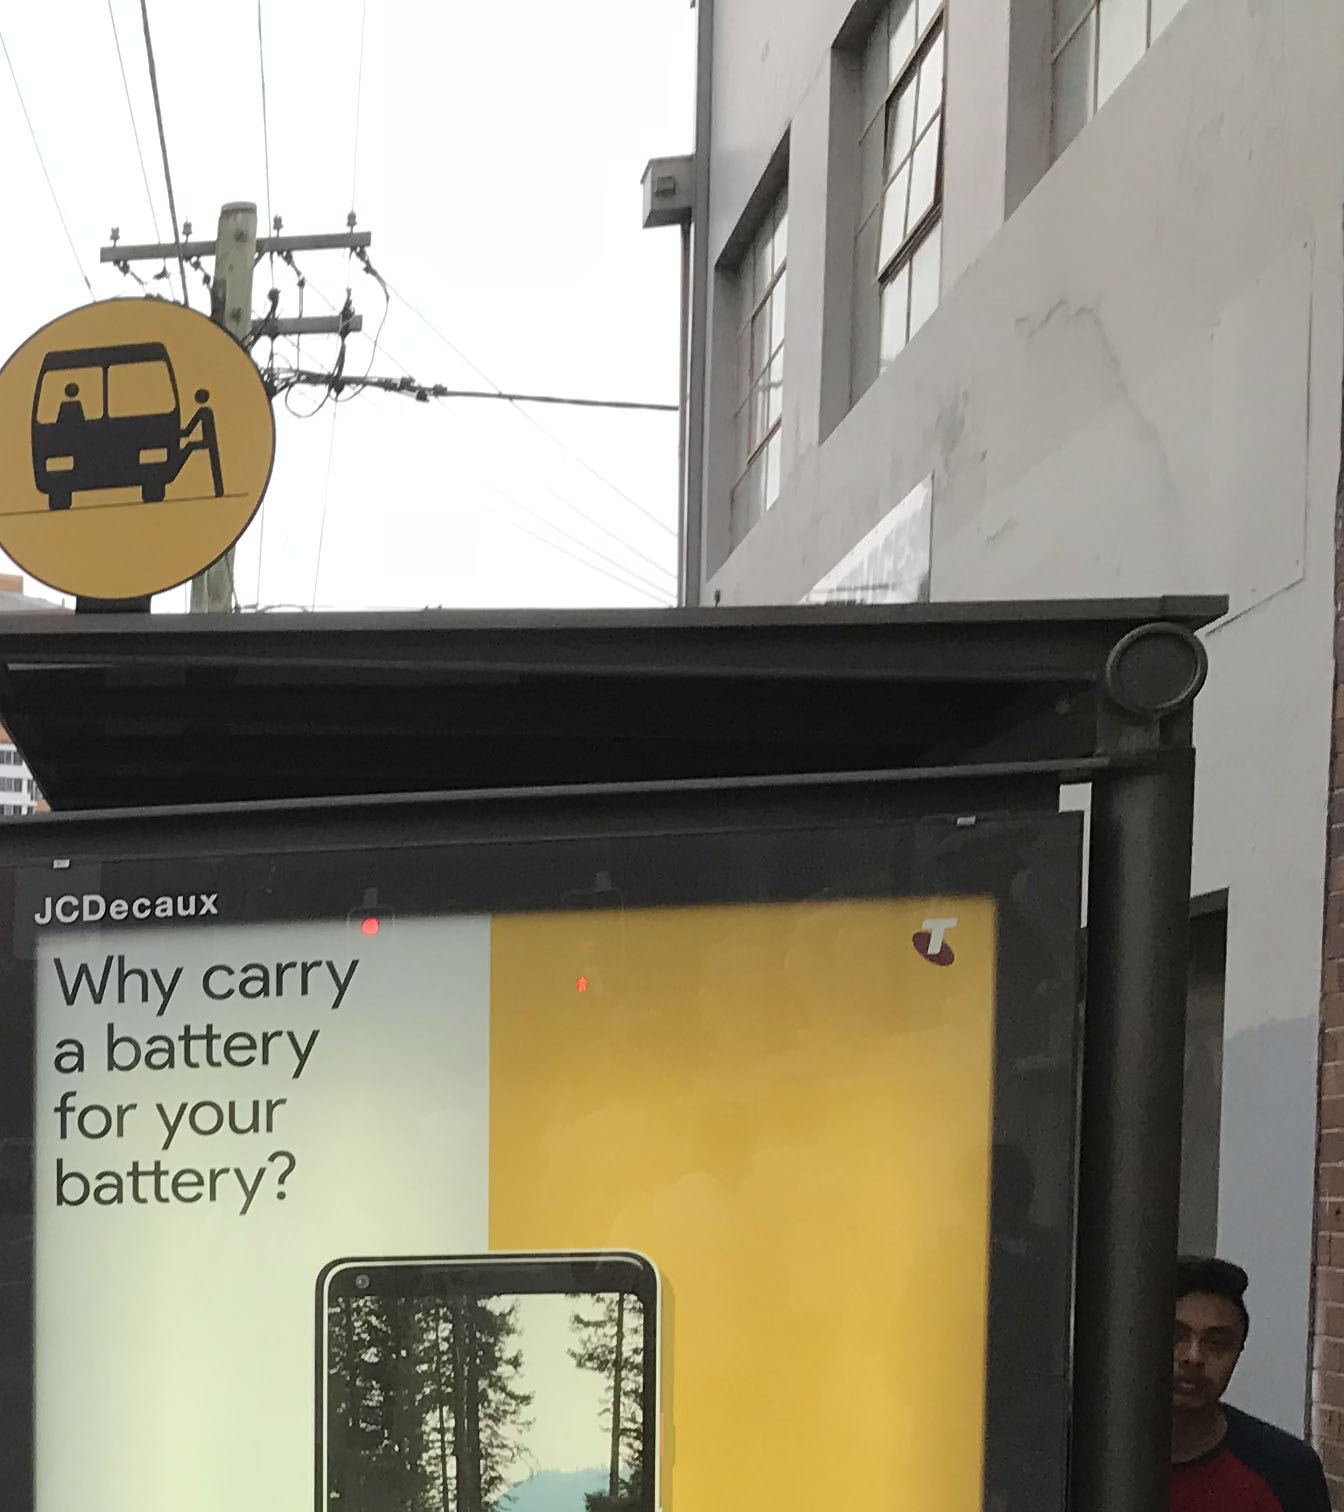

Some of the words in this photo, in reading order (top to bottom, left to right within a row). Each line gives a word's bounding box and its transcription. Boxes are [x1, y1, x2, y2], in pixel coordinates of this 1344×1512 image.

[34, 893, 219, 925] JCDecaux
[53, 955, 184, 1017] Why
[202, 958, 360, 1010] carry
[54, 1036, 85, 1074] a
[107, 1022, 321, 1080] battery
[54, 1090, 138, 1140] for
[156, 1097, 288, 1151] your
[56, 1150, 297, 1216] battery?
